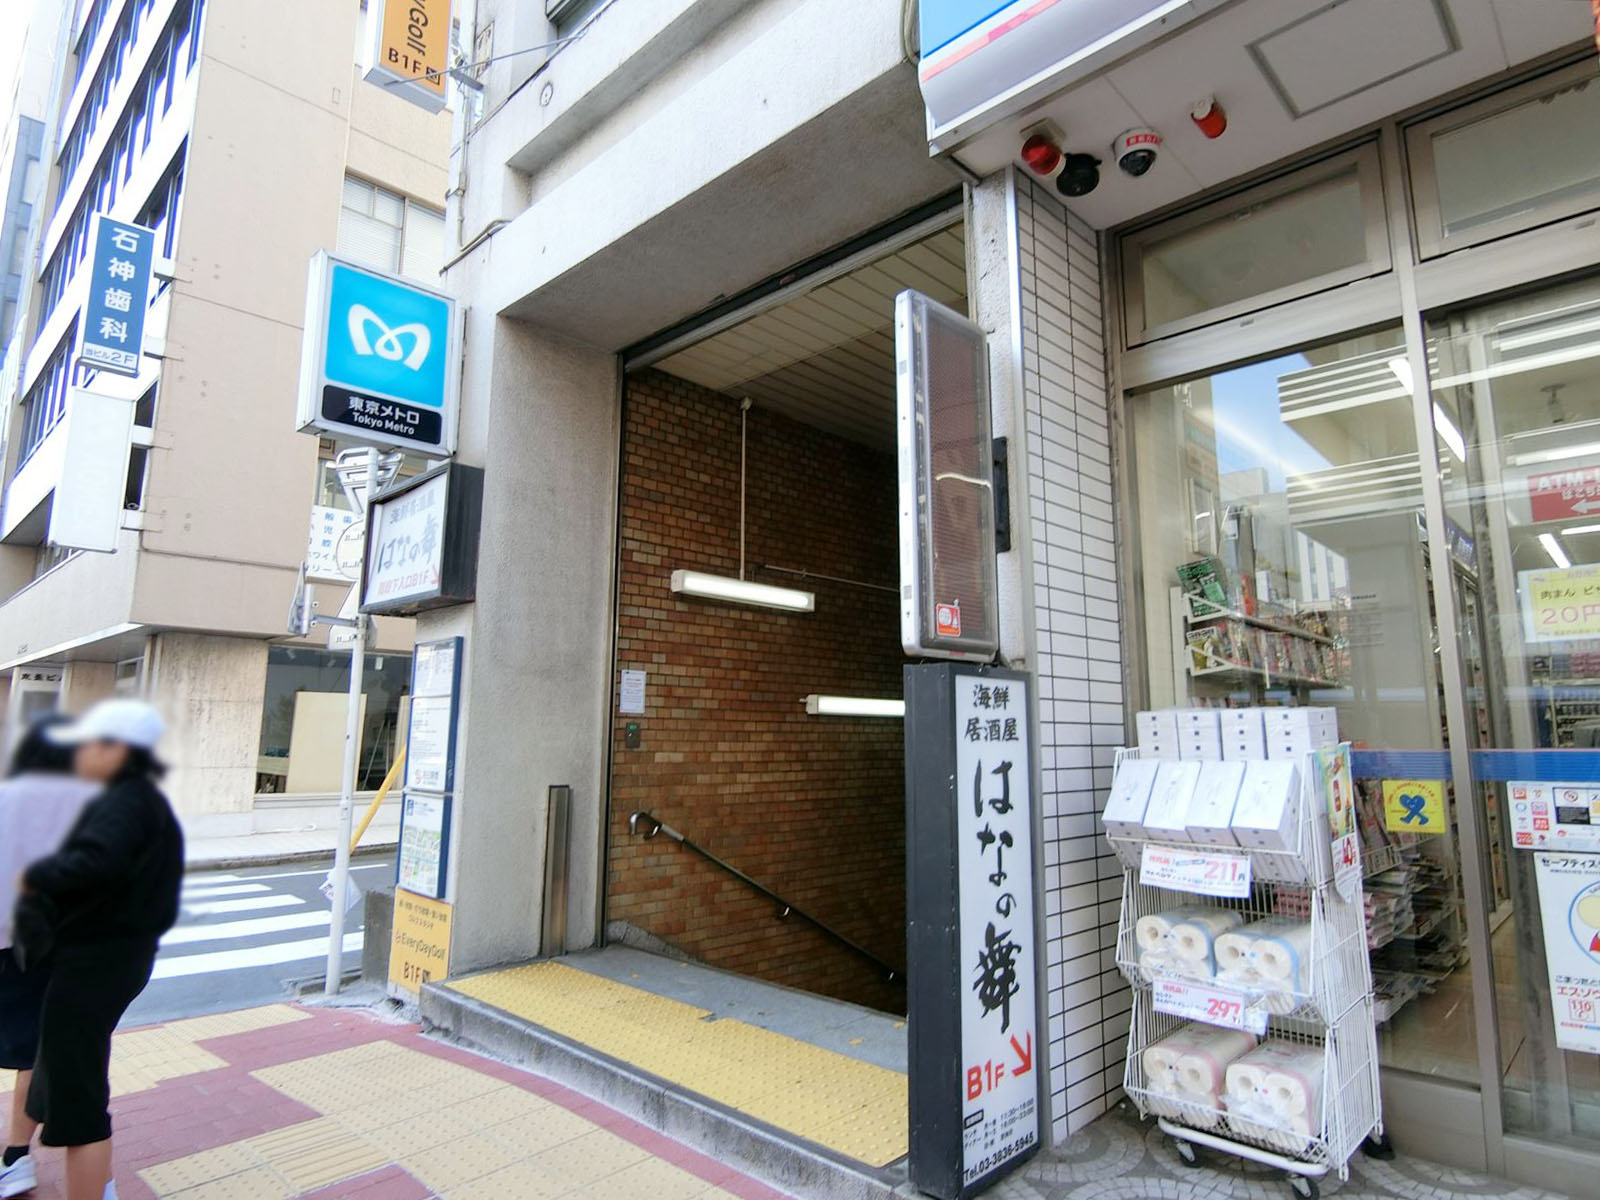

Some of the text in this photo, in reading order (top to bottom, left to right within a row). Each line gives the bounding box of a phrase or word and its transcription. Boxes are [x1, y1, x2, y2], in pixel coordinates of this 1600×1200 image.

[388, 47, 422, 74] B1F
[99, 227, 140, 344] 石神歯科
[348, 396, 420, 425] 東京メトロ
[352, 411, 415, 435] Tokyo Metro
[973, 683, 1011, 711] 海鮮
[964, 716, 1020, 743] 居酒屋
[972, 758, 1022, 1035] はなの舞
[966, 1059, 1005, 1102] B1F
